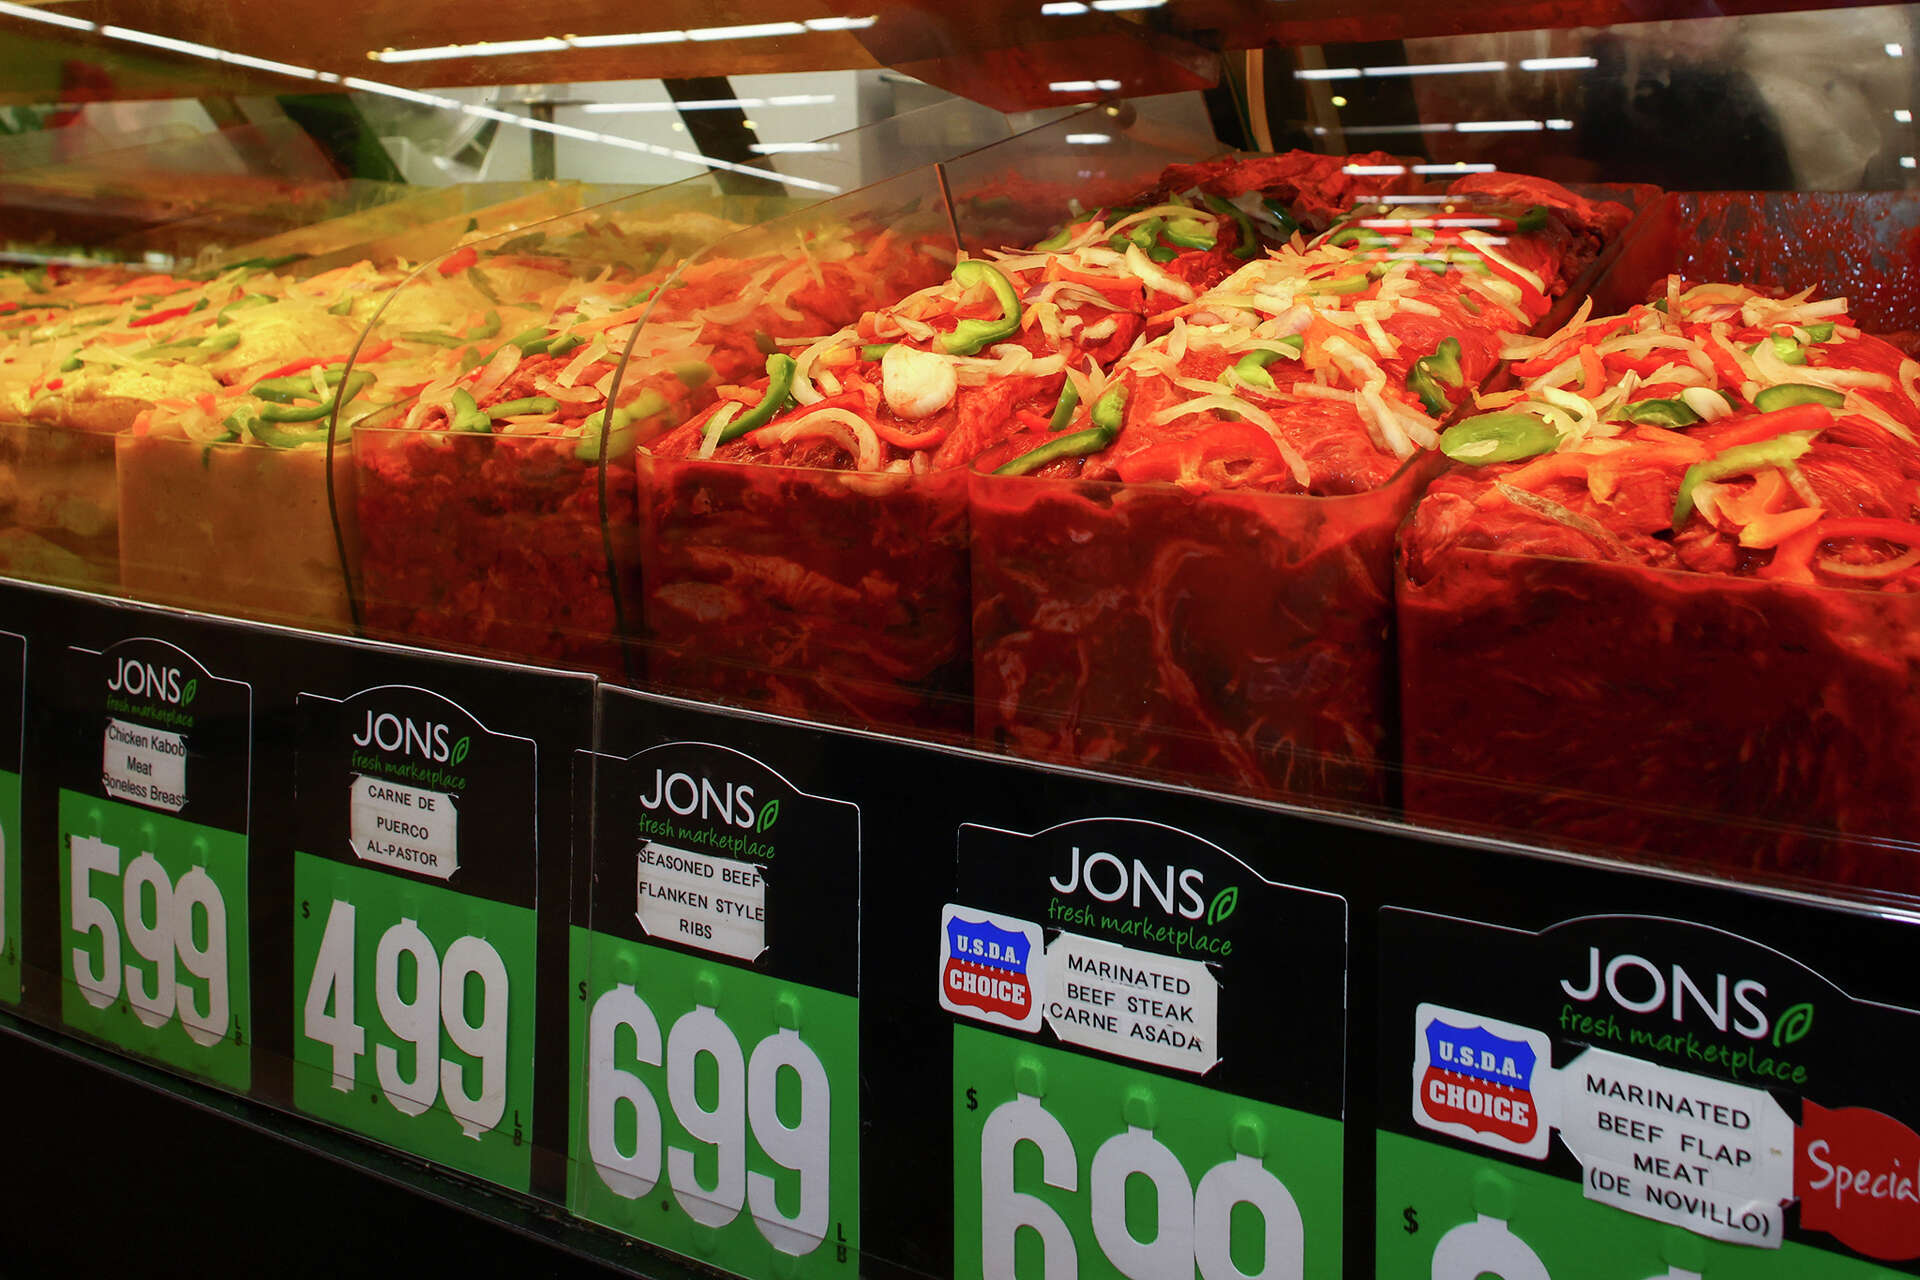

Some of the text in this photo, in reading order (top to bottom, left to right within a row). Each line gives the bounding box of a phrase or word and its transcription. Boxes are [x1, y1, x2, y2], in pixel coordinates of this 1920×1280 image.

[107, 657, 181, 704] JONS
[108, 724, 186, 757] Chicken Kabob
[352, 710, 450, 763] JONS
[127, 755, 152, 776] Meat
[352, 750, 466, 790] fresh marketplace
[103, 772, 187, 807] Boneless Breast
[368, 785, 436, 812] CARNE DE
[640, 768, 755, 829] JONS
[377, 816, 429, 840] PUERCO
[639, 812, 775, 859] fresh marketplace
[367, 840, 438, 868] AL-PASTOR
[639, 849, 761, 888] SEASONED BEEF
[639, 881, 765, 922] FLANKEN STYLE
[1050, 846, 1204, 920] JONS
[680, 918, 712, 939] RIBS
[1048, 897, 1233, 956] fresh marketplace
[956, 934, 1021, 965] U.S.D.A.
[950, 968, 1026, 1006] CHOICE
[1068, 953, 1190, 995] MARINATED
[1560, 946, 1769, 1040] JONS
[1067, 983, 1194, 1024] BEEF STEAK
[1050, 1002, 1203, 1052] CARNE ASADA
[1560, 1004, 1808, 1084] fresh marketplace
[1439, 1039, 1523, 1080] U.S.D.A.
[966, 1087, 978, 1112] $
[1429, 1079, 1530, 1128] CHOICE
[1586, 1074, 1751, 1131] MARINATED
[1597, 1111, 1752, 1168] BEEF FLAP
[1634, 1155, 1708, 1187] MEAT
[1403, 1207, 1419, 1235] $
[1589, 1170, 1770, 1237] (DE NOVILLO)
